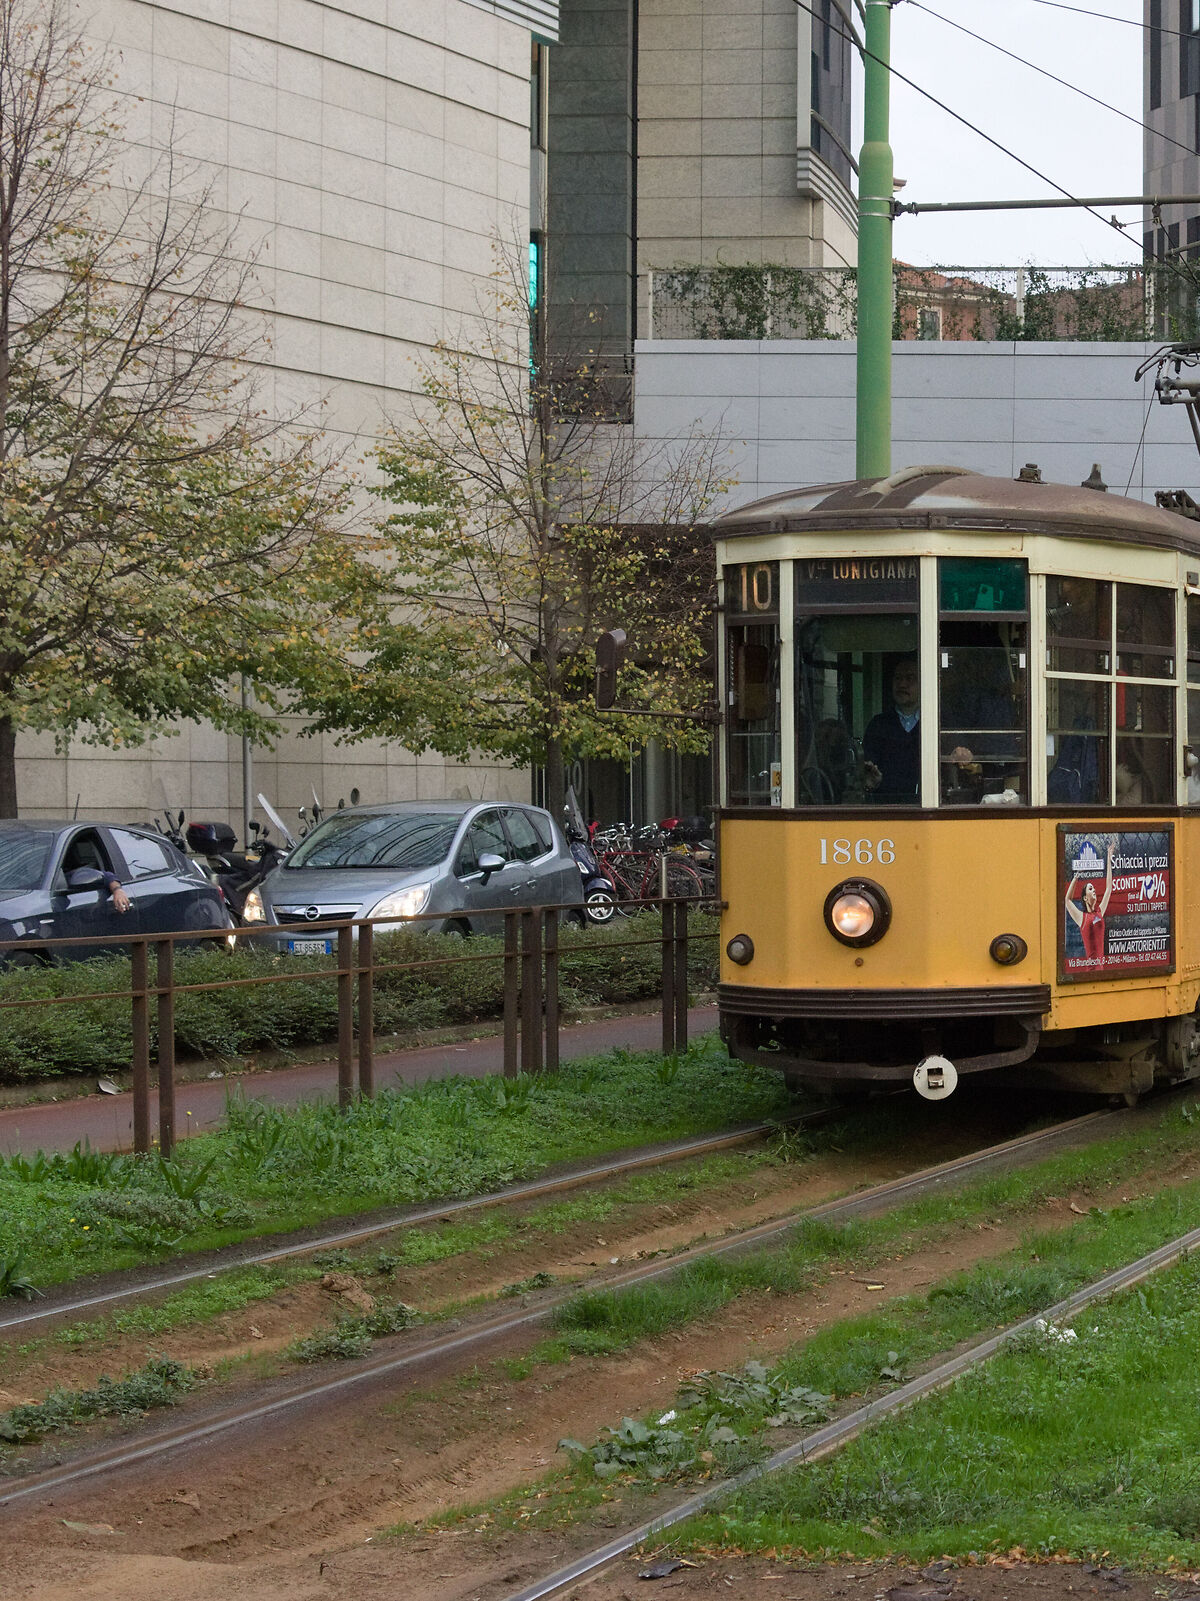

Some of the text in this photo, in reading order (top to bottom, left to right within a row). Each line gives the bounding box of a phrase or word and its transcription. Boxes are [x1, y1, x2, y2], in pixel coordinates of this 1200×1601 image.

[832, 560, 917, 580] LUNIGIANA
[740, 563, 772, 611] 10
[819, 838, 896, 865] 1866
[1074, 860, 1103, 869] ARTORIENT
[1111, 854, 1143, 869] Schiaccia
[1149, 853, 1168, 871] prezzi
[1112, 877, 1137, 891] SCONTI
[1127, 903, 1133, 912] SU
[1134, 902, 1147, 911] TUTTI
[1150, 901, 1166, 911] TAPPETI
[1108, 938, 1167, 954] WWW.ARTORIENT.IT
